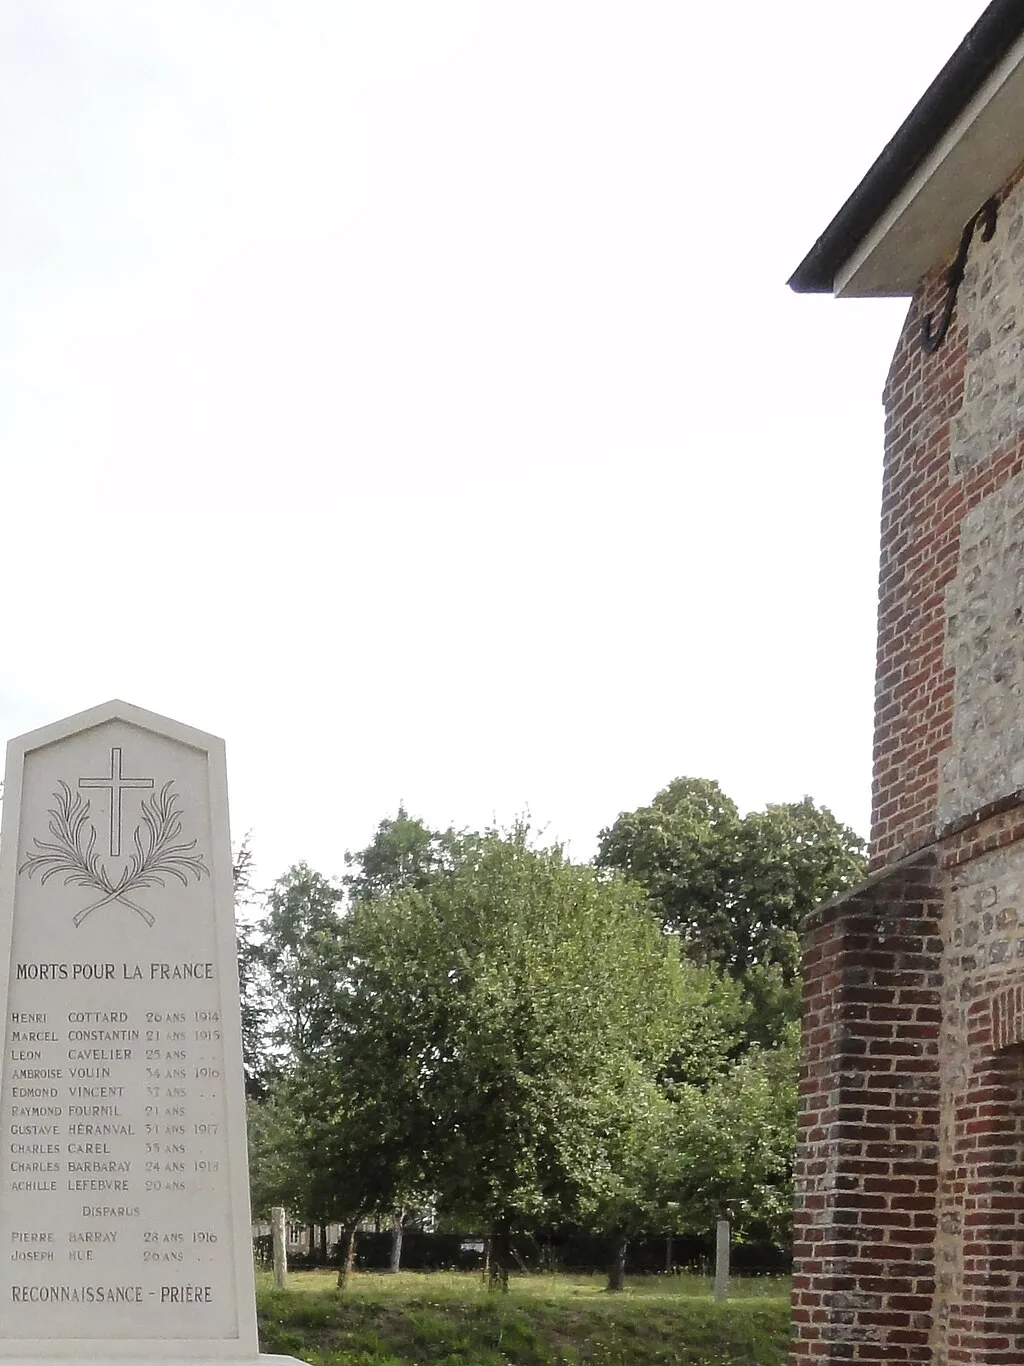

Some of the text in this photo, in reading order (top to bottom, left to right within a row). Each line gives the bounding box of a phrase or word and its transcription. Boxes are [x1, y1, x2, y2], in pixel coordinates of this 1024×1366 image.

[16, 963, 213, 980] MORTS POUR LA FRANCE
[11, 1012, 47, 1023] HENRI
[68, 1012, 128, 1023] COTTARD
[165, 1013, 186, 1023] ANS
[194, 1012, 219, 1022] 1914
[11, 1029, 220, 1042] MARCEL CONSTANTIN 21 ANS 1915
[11, 1049, 187, 1061] LEON CAVELIER 25 ANS
[12, 1069, 63, 1079] AMBROISE
[69, 1068, 111, 1078] VOUIN
[165, 1069, 187, 1079] ANS
[195, 1068, 220, 1079] 1916
[11, 1087, 58, 1098] EDMOND
[69, 1087, 125, 1098] VINCENT
[165, 1088, 187, 1098] ANS
[11, 1105, 185, 1117] RAYMOND FOURNIL 21 ANS
[10, 1124, 59, 1135] GUSTAVE
[68, 1122, 135, 1135] HÉRANVAL
[164, 1125, 185, 1135] ANS
[193, 1124, 219, 1135] 1917
[10, 1143, 60, 1154] CHARLES
[68, 1143, 111, 1154] CAREL
[164, 1144, 186, 1154] ANS
[10, 1162, 60, 1172] CHARLES
[68, 1161, 131, 1172] BARBARAY
[145, 1162, 161, 1172] 24
[164, 1162, 185, 1172] ANS
[10, 1180, 186, 1191] ACHILLE LEFEBVRE 20 ANS
[82, 1206, 141, 1217] DISPARUS
[10, 1232, 54, 1243] PIERRE
[162, 1233, 184, 1243] ANS
[192, 1232, 218, 1243] 1916
[10, 1251, 54, 1261] JOSEPH
[68, 1250, 93, 1261] HUE
[162, 1251, 184, 1261] ANS
[11, 1285, 143, 1303] RECONNAISSANCE
[160, 1284, 212, 1303] PRIÈRE
